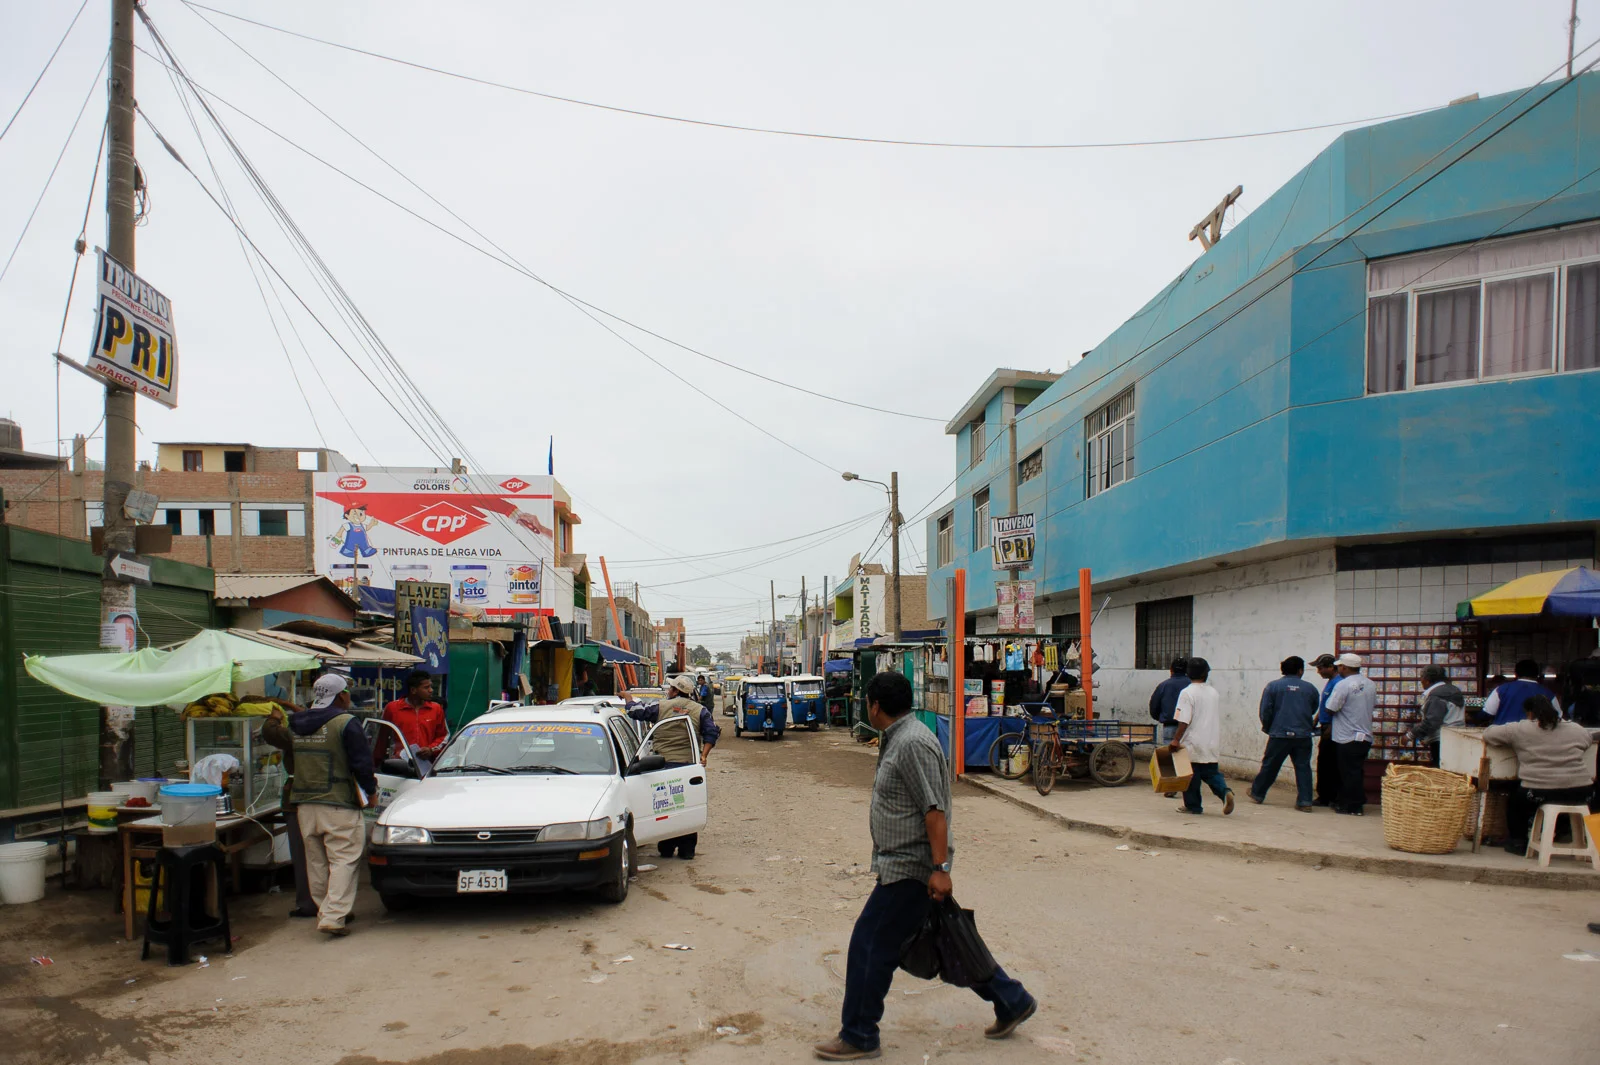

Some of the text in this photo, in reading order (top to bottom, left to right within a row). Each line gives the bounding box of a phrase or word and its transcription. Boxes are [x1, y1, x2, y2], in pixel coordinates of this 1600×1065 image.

[112, 289, 167, 328] PRESIDENTE REGIONAL
[103, 305, 170, 384] PRI
[96, 364, 138, 388] MARCA
[341, 478, 364, 488] Fast
[506, 481, 523, 489] CPP
[422, 515, 467, 532] CPP
[998, 515, 1033, 531] TRIVEÑO
[383, 548, 429, 556] PINTURAS
[431, 548, 443, 556] DE
[446, 548, 477, 556] LARGA
[1001, 537, 1034, 561] PRI
[399, 585, 448, 600] LLAVES
[509, 579, 539, 591] pintor
[527, 724, 583, 733] Express
